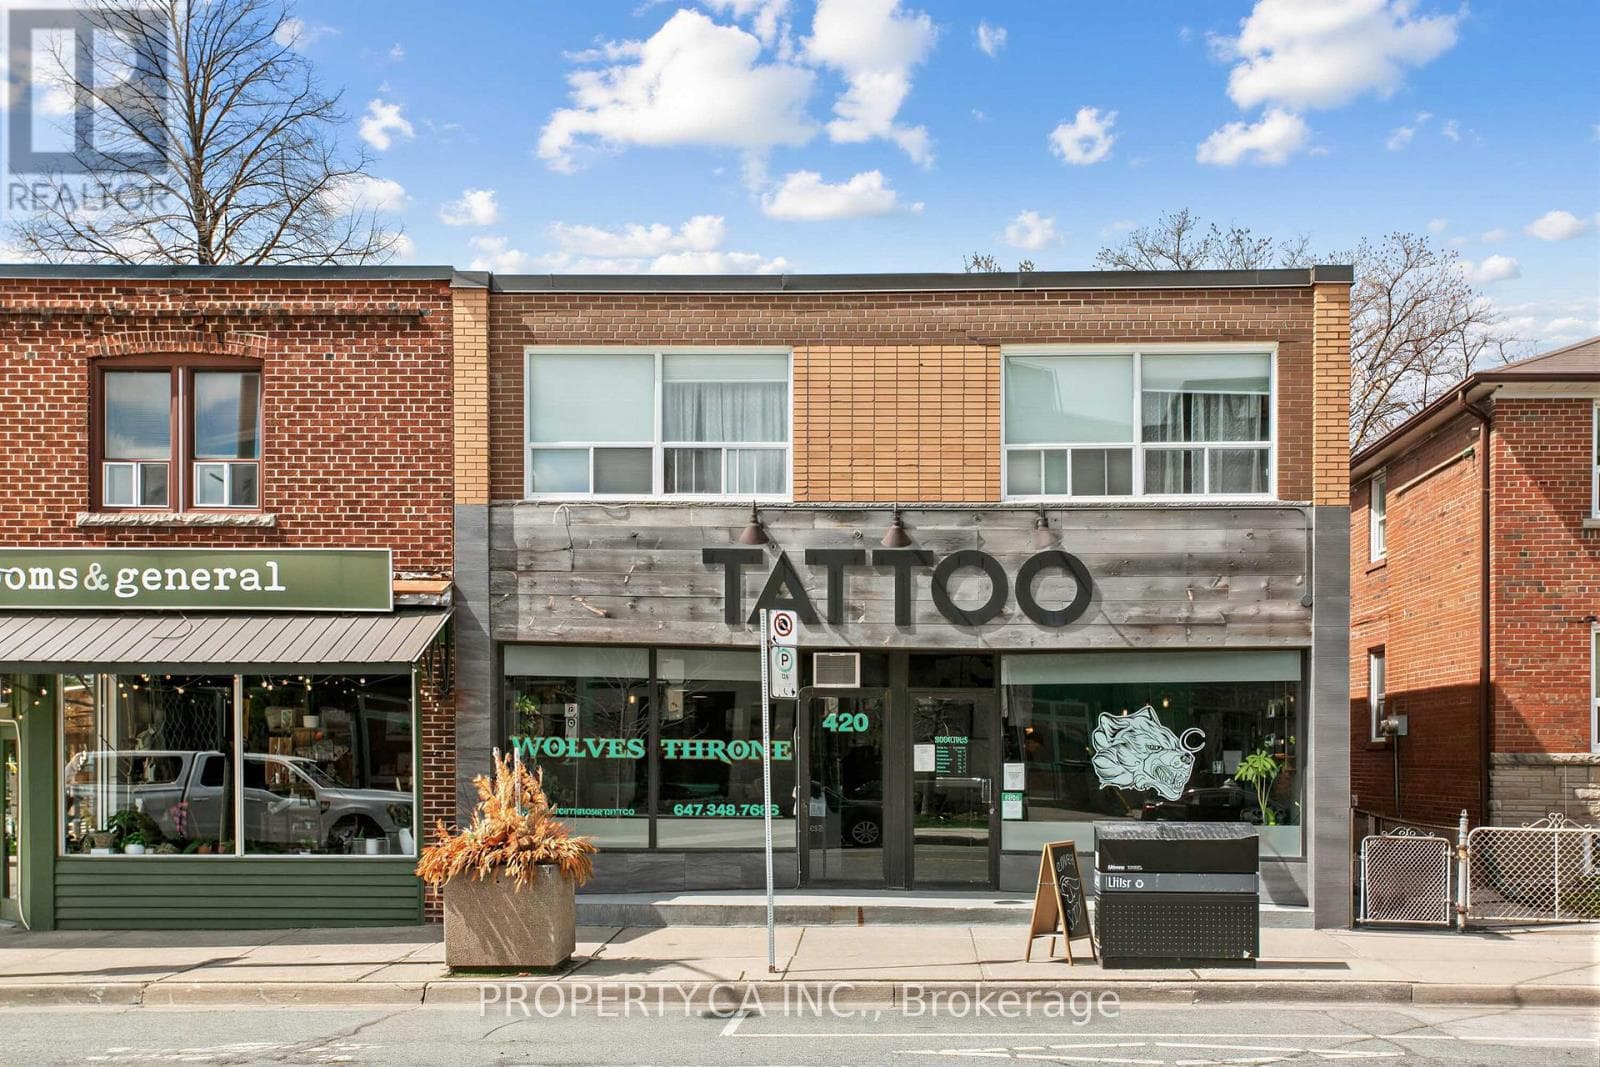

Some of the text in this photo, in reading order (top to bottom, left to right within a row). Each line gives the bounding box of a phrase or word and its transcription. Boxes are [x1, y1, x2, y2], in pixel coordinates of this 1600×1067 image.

[0, 561, 286, 598] oms&general
[702, 548, 1093, 627] TATTOO
[781, 653, 789, 666] P
[822, 712, 869, 733] 420
[509, 735, 793, 766] WOLVES THRONE
